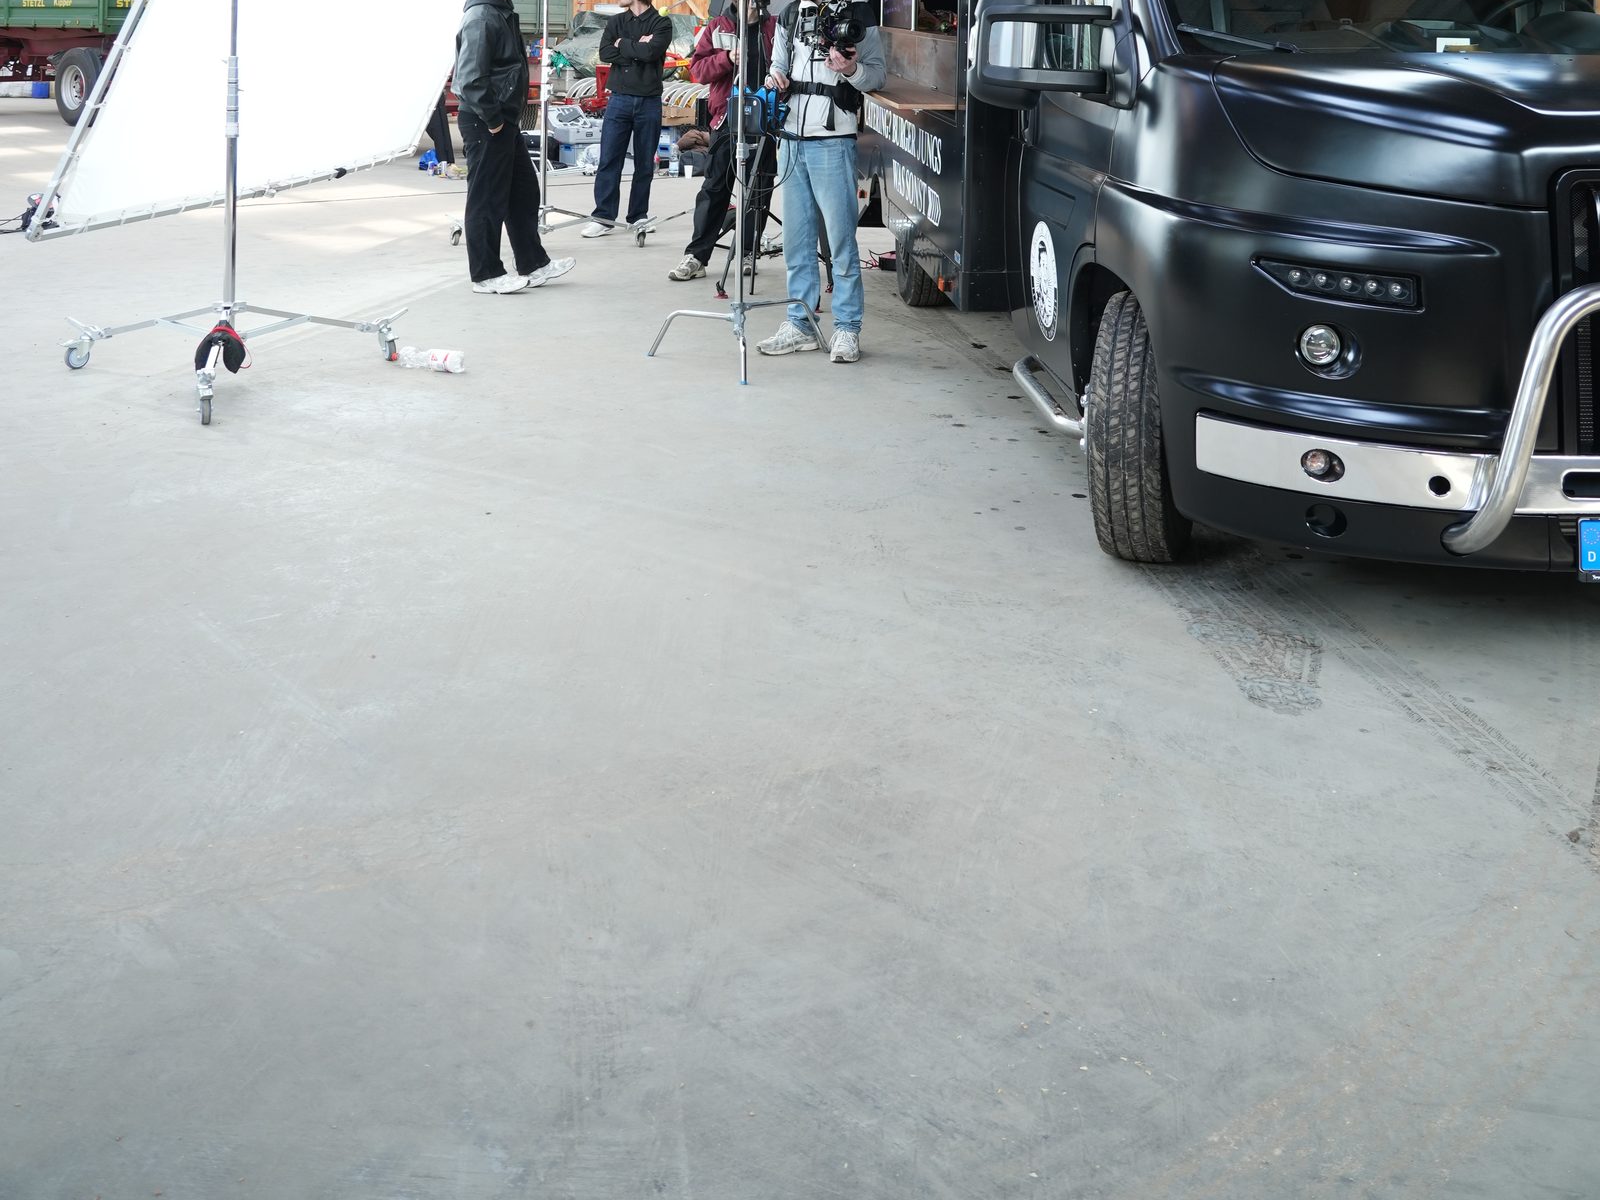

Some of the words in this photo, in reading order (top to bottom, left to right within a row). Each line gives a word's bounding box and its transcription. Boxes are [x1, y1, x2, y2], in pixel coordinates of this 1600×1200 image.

[864, 99, 892, 141] CATERING?
[892, 113, 917, 158] BURGER
[916, 128, 942, 175] JUNGS
[892, 158, 905, 197] WAS
[905, 168, 927, 216] SONST
[1588, 551, 1597, 562] D
